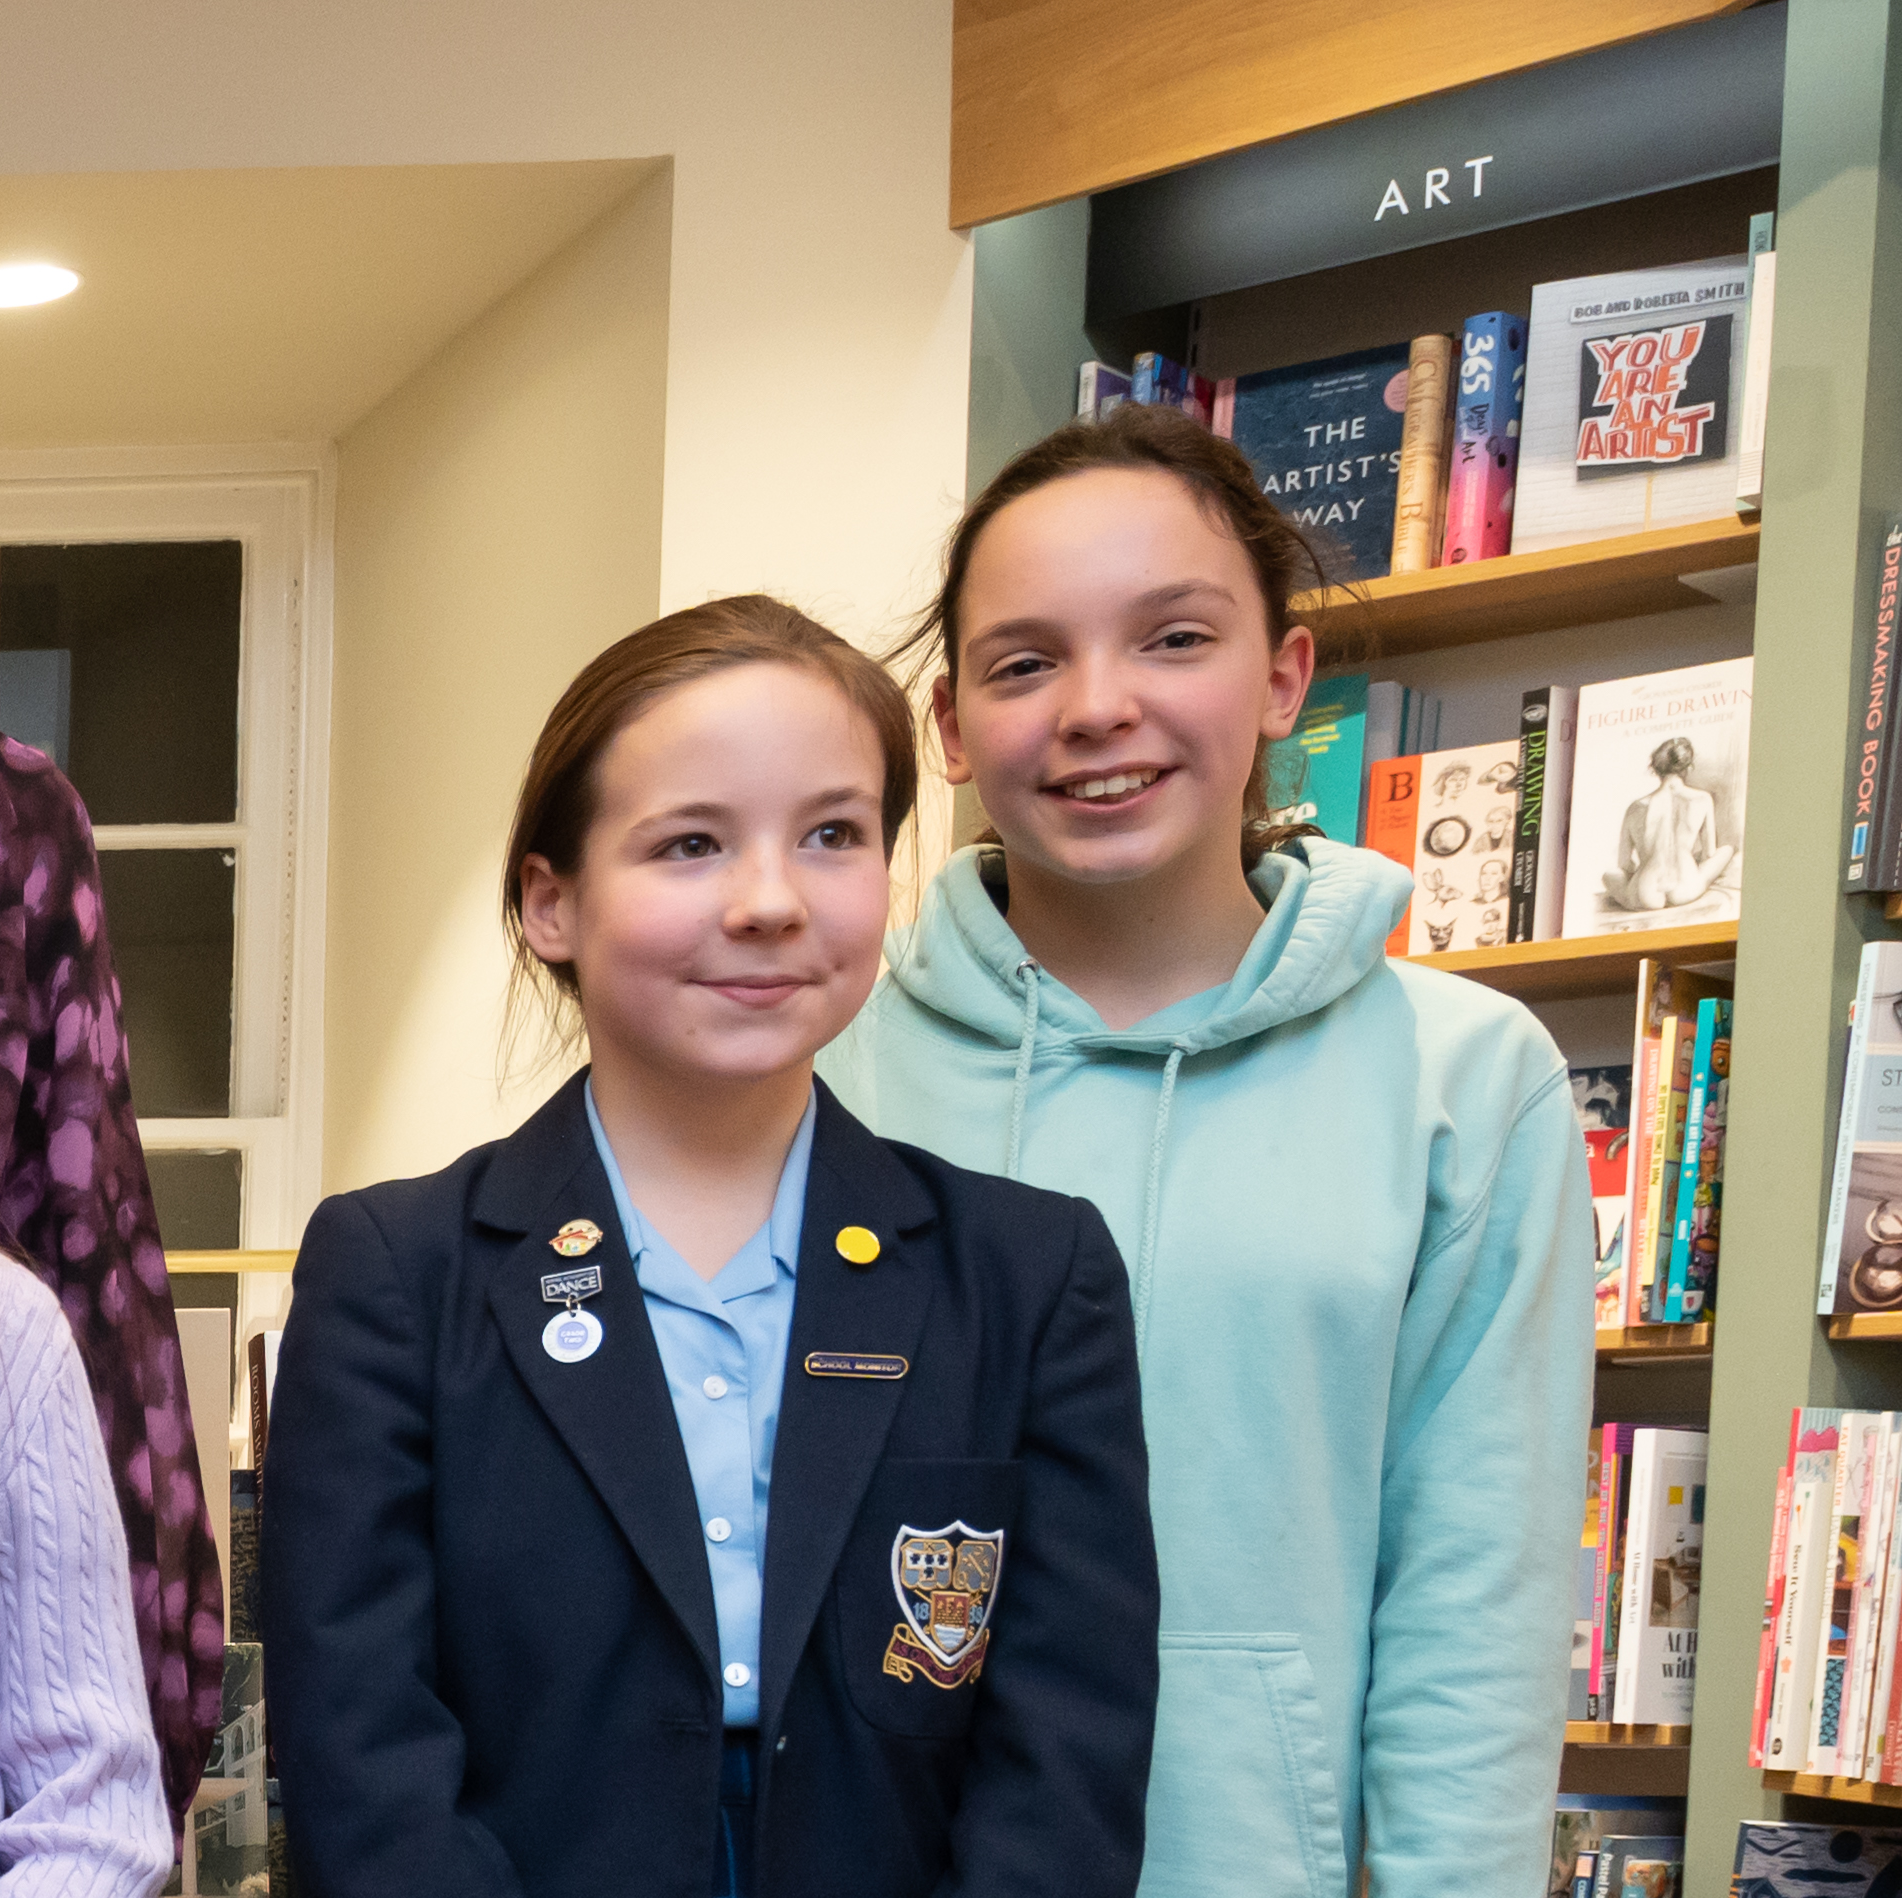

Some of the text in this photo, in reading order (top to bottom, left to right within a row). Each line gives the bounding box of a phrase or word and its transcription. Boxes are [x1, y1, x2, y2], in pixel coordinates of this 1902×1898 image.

[1374, 157, 1495, 222] ART
[1574, 282, 1745, 318] BOB AND ROBERTA SMITH
[1461, 331, 1495, 395] 365
[1592, 326, 1701, 371] YOU
[1598, 362, 1680, 403] ARE
[1303, 417, 1366, 448] THE
[1577, 406, 1711, 460] ARTIST
[1611, 396, 1670, 428] AN
[1262, 452, 1401, 494] ARTIST'S
[1293, 498, 1365, 527] WAY
[1856, 547, 1902, 816] DRESSMAKING BOOK
[1587, 704, 1658, 731] FIGURE
[1522, 729, 1546, 837] DRAWING
[546, 1276, 598, 1297] DANCE
[1784, 1589, 1798, 1646] Yourself
